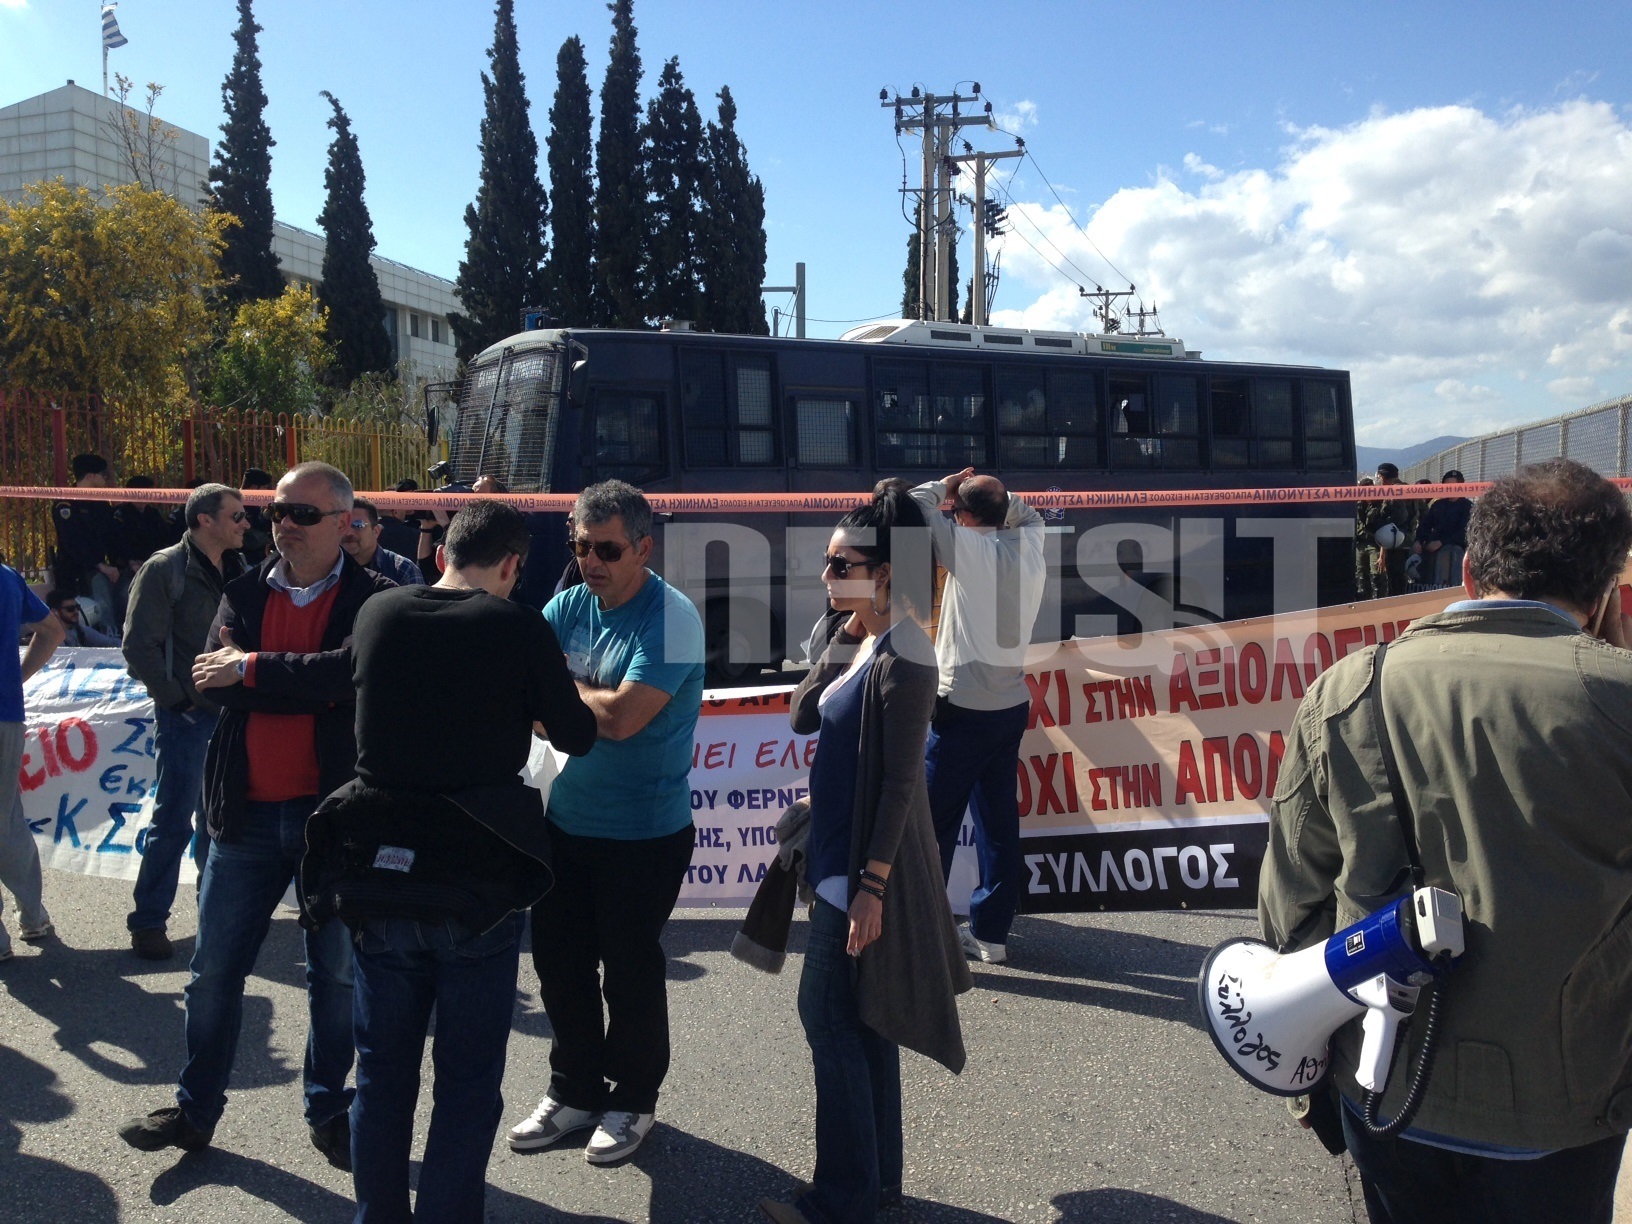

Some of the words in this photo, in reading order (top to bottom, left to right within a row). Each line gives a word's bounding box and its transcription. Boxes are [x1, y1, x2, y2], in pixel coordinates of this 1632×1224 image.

[1082, 675, 1157, 724] ΣΤΗΝ
[1088, 763, 1162, 811] ΣΤΗΝ
[1024, 842, 1240, 895] ΣΥΛΛΟΓΟΣ
